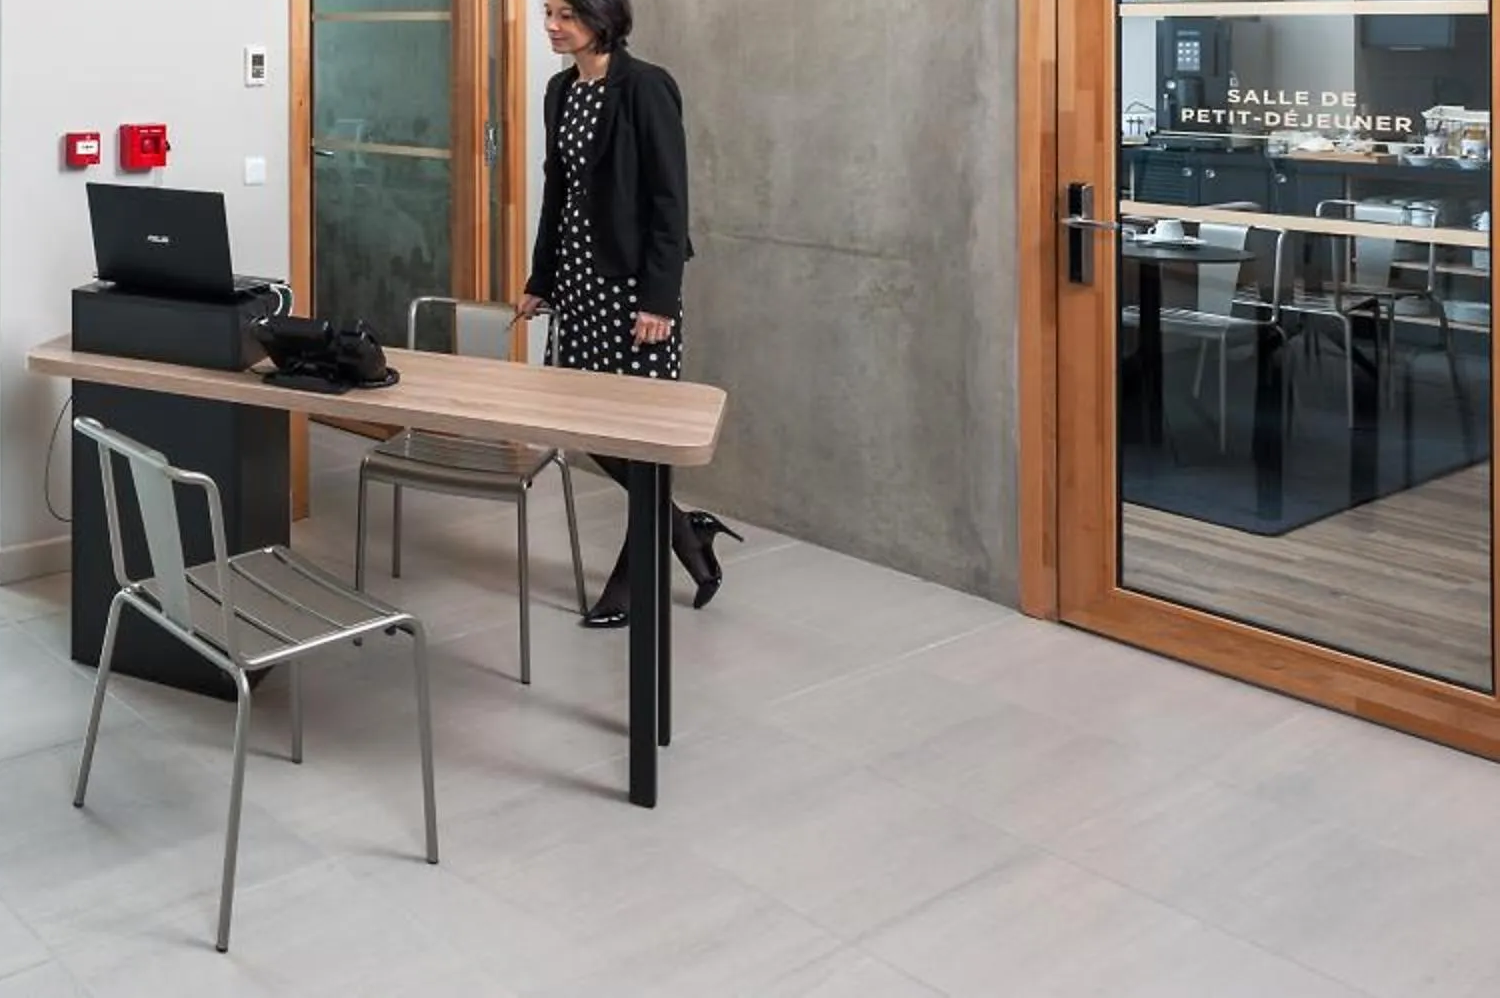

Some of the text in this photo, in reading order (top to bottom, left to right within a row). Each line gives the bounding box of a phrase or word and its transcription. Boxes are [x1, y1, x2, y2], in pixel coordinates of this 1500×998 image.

[1227, 89, 1357, 108] SALLE DE
[1181, 107, 1413, 133] PETIT-DÉJEUNER
